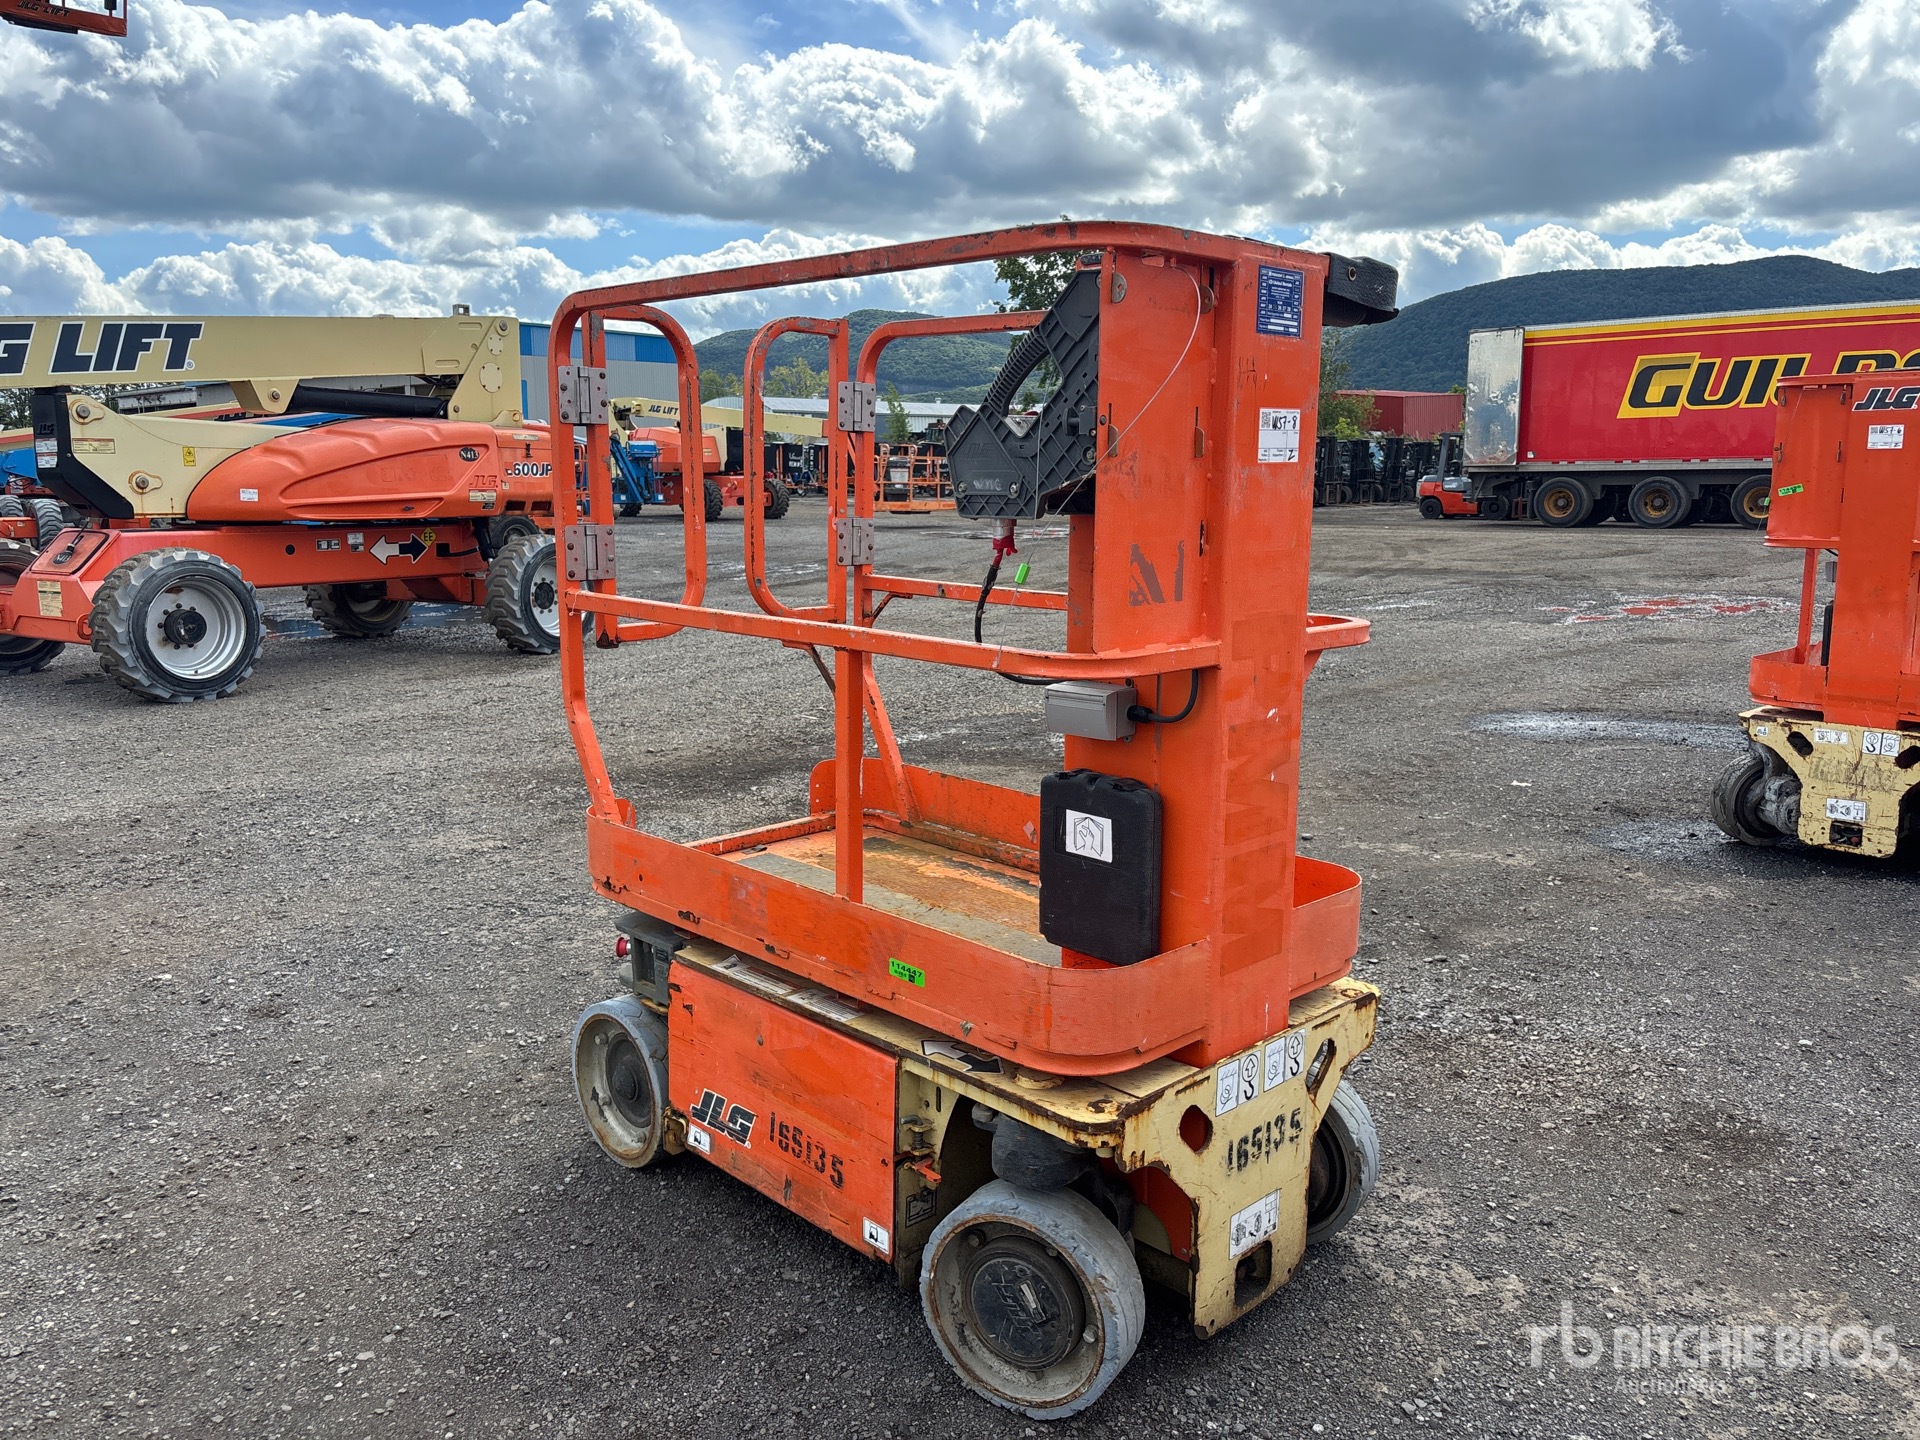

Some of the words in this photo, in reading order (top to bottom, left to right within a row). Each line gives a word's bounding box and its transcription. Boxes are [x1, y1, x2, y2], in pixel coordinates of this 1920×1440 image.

[48, 321, 205, 375] LIFT
[1853, 386, 1920, 411] JLG
[648, 404, 662, 413] JLG
[662, 406, 679, 415] LIFT
[460, 449, 479, 459] N413
[468, 474, 498, 488] JLG
[423, 531, 434, 541] EE
[890, 961, 923, 978] 114447
[690, 1087, 757, 1148] JLG
[1226, 1107, 1303, 1173] 165135
[768, 1111, 845, 1191] 165135
